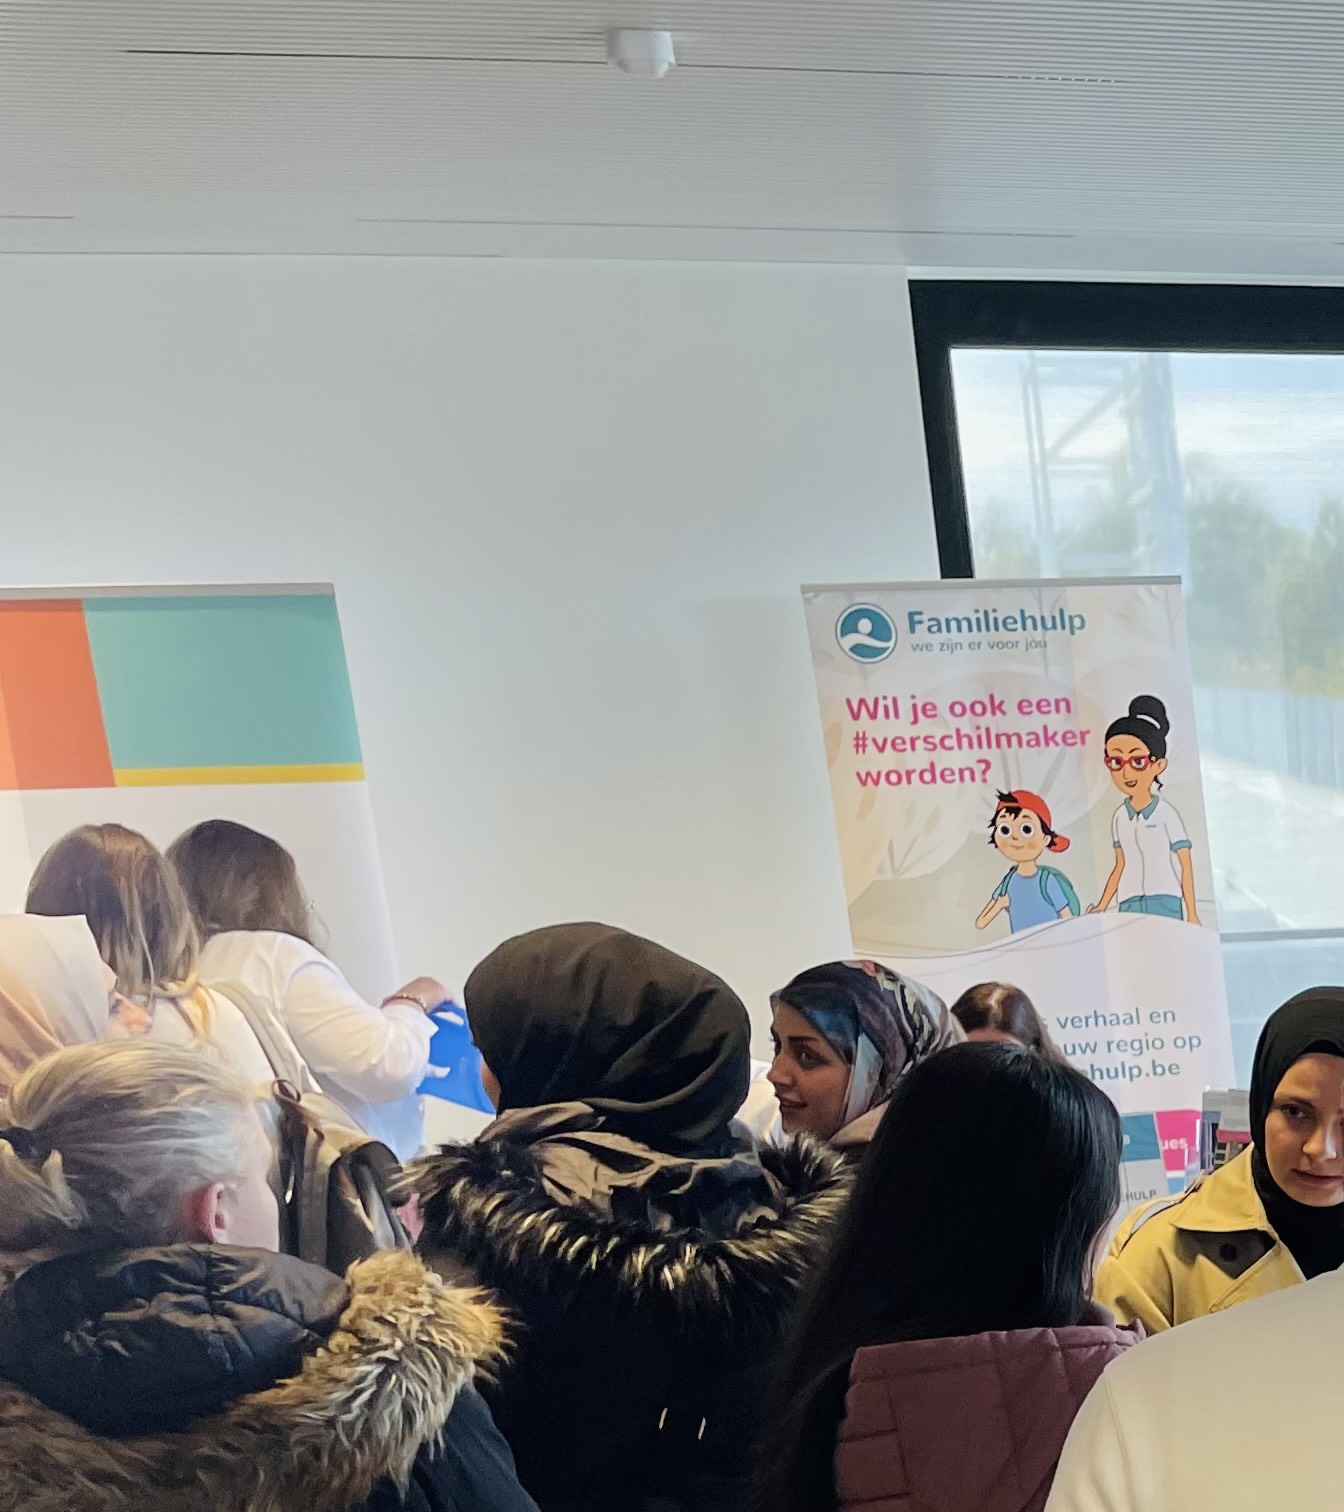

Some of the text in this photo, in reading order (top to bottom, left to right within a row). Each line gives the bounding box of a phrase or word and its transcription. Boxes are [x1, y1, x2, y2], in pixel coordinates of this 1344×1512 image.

[906, 608, 1087, 636] Familiehulp
[910, 637, 1048, 655] we zijn er voor jou
[845, 692, 1072, 725] Wil je ook een
[852, 725, 1092, 755] #verschilmaker
[856, 758, 992, 788] worden?
[1056, 1007, 1177, 1030] verhaal en
[1106, 1033, 1166, 1058] regio
[1172, 1033, 1202, 1053] op
